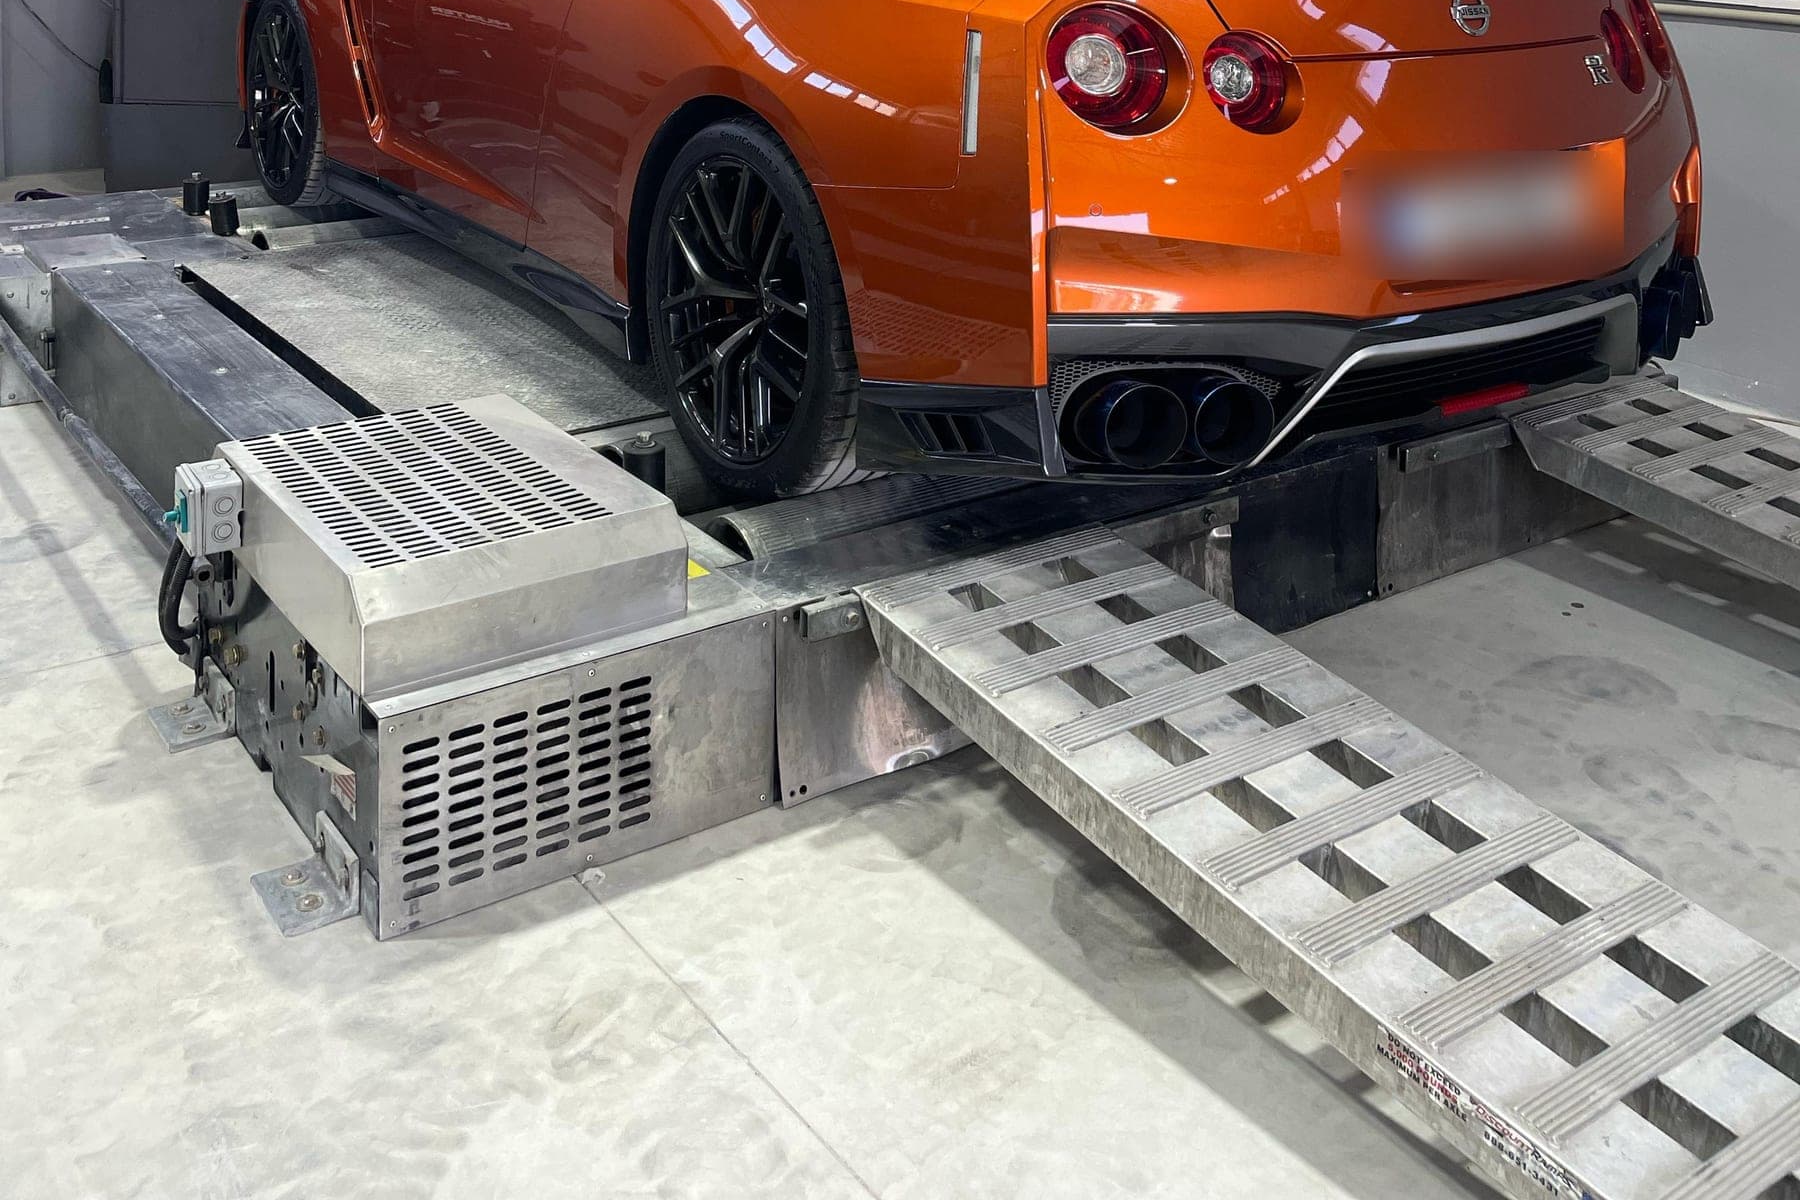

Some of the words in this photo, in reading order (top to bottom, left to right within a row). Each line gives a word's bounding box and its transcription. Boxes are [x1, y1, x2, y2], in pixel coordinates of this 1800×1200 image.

[1458, 7, 1488, 17] NISSAN
[1377, 1044, 1420, 1084] MAXIMUM
[1422, 1081, 1441, 1100] PER
[1443, 1098, 1468, 1122] AXLE
[1387, 1033, 1401, 1048] DO
[1402, 1045, 1424, 1064] NOT
[1424, 1062, 1461, 1095] EXCEED
[1387, 1043, 1414, 1069] 5,000
[1416, 1065, 1458, 1104] POUNDS
